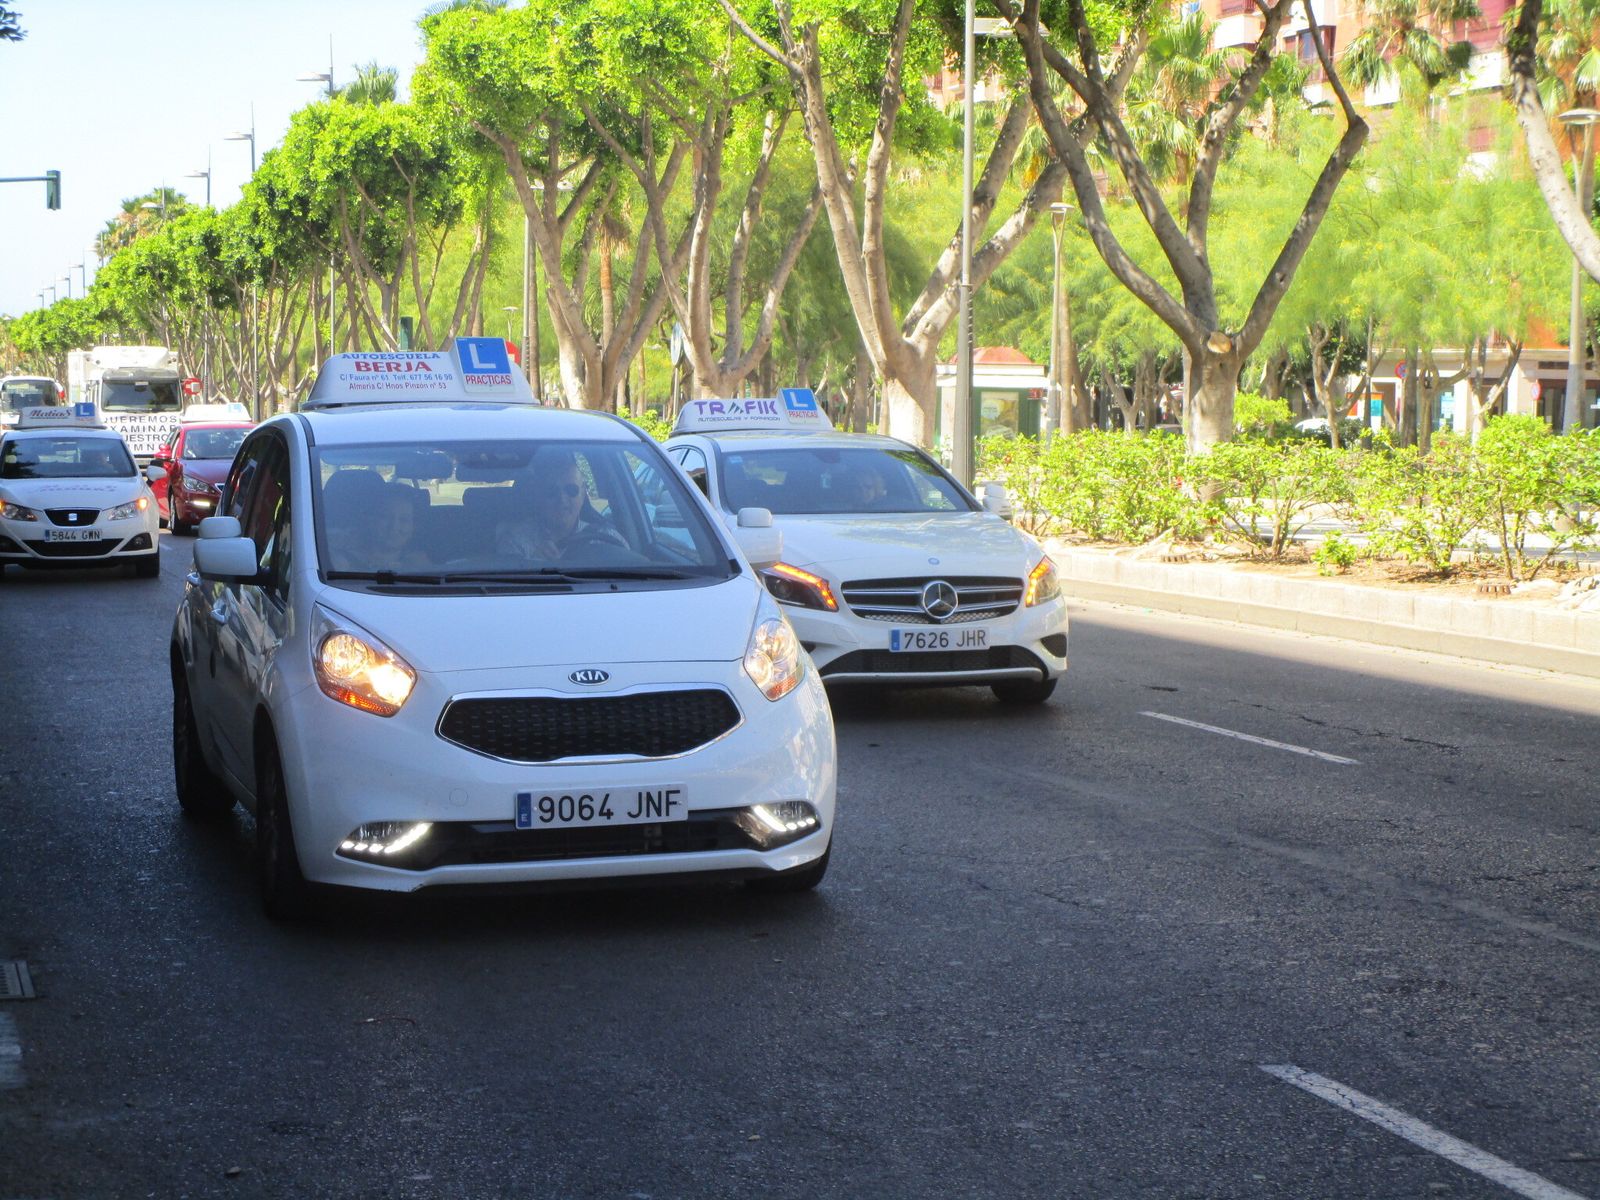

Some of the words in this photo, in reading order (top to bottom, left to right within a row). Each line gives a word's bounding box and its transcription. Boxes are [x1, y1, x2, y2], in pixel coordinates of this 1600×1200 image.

[468, 343, 497, 369] L
[354, 361, 433, 373] BERJA
[51, 530, 77, 540] 5844
[904, 632, 949, 649] 7626
[956, 630, 986, 647] JHR
[575, 671, 605, 681] KIA
[538, 793, 614, 823] 9064
[627, 790, 681, 819] JNF
